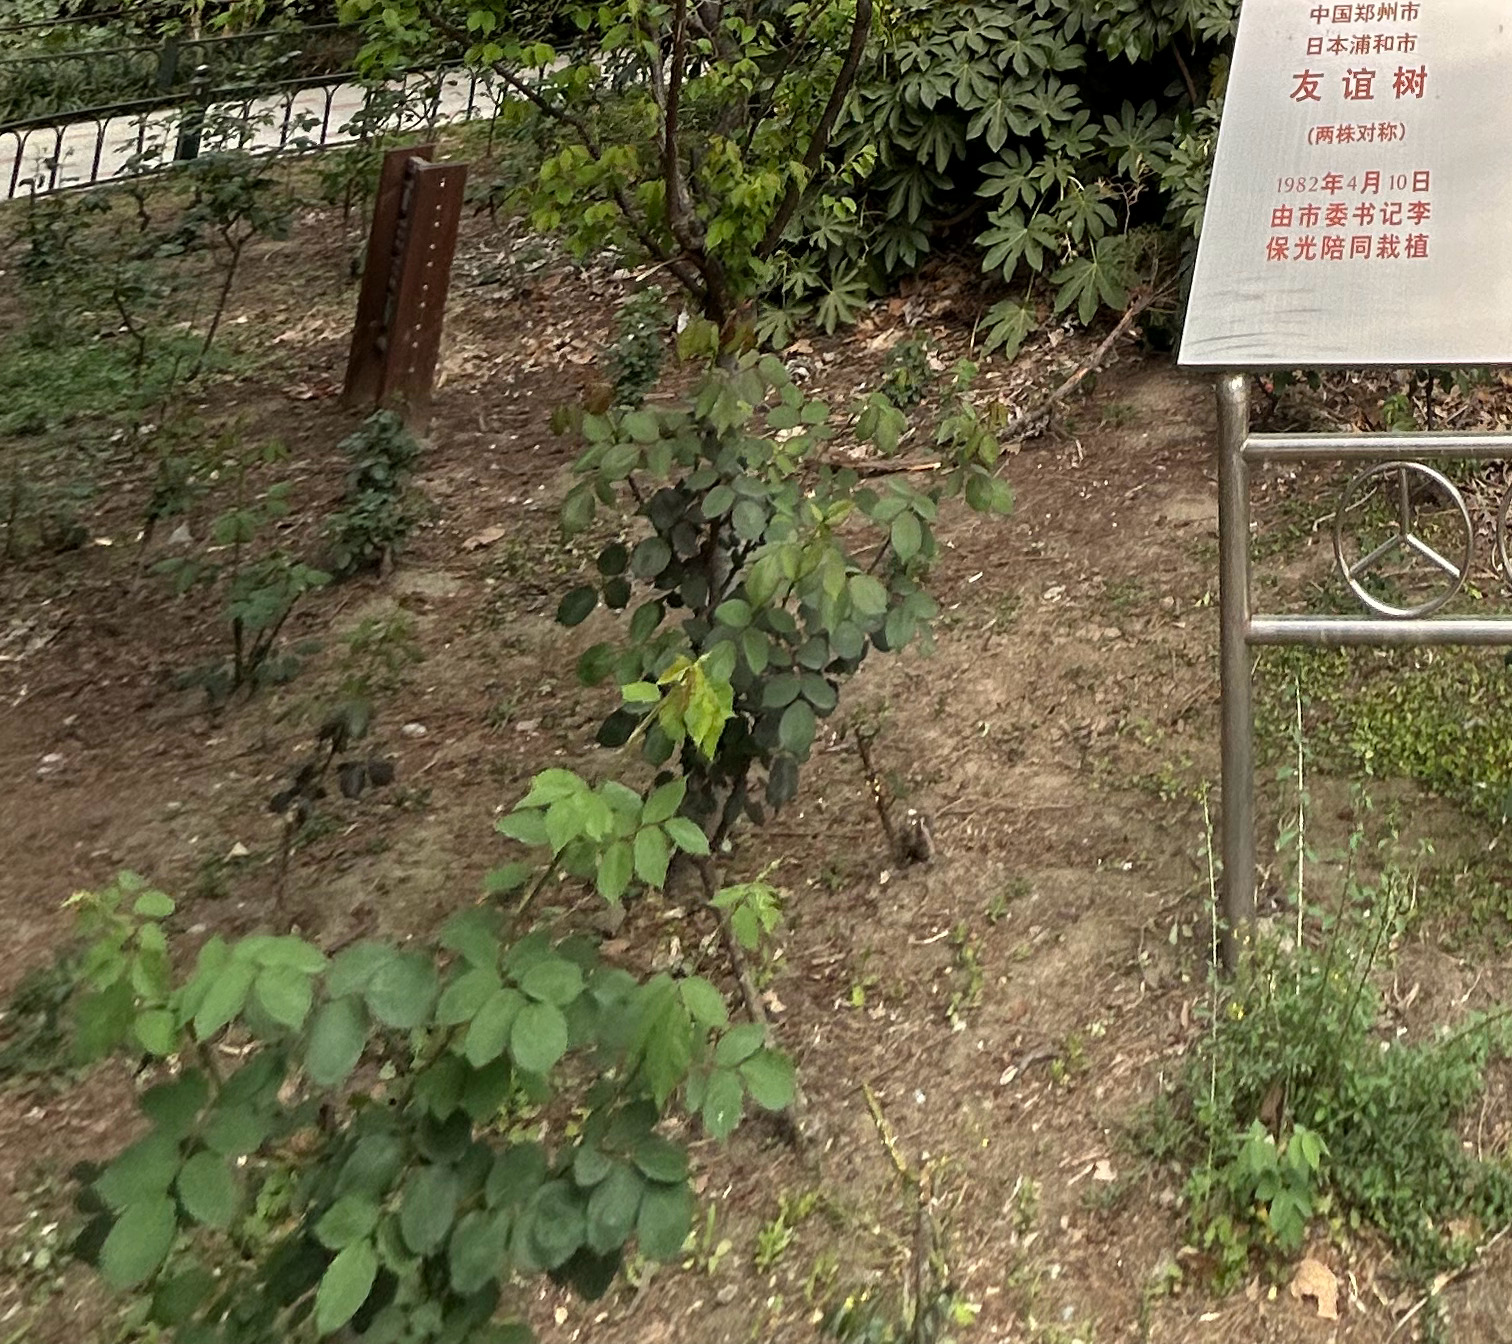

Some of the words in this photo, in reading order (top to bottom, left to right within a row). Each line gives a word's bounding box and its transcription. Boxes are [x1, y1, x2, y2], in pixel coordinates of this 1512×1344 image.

[1310, 1, 1421, 25] 中国郑州市
[1306, 32, 1418, 56] 日本浦和市
[1289, 65, 1428, 103] 友谊树
[1307, 121, 1406, 146] (两株对称)
[1277, 170, 1431, 195] 1982年4月10日
[1271, 200, 1432, 228] 由市委书记李
[1266, 233, 1430, 262] 保光陪同栽植
